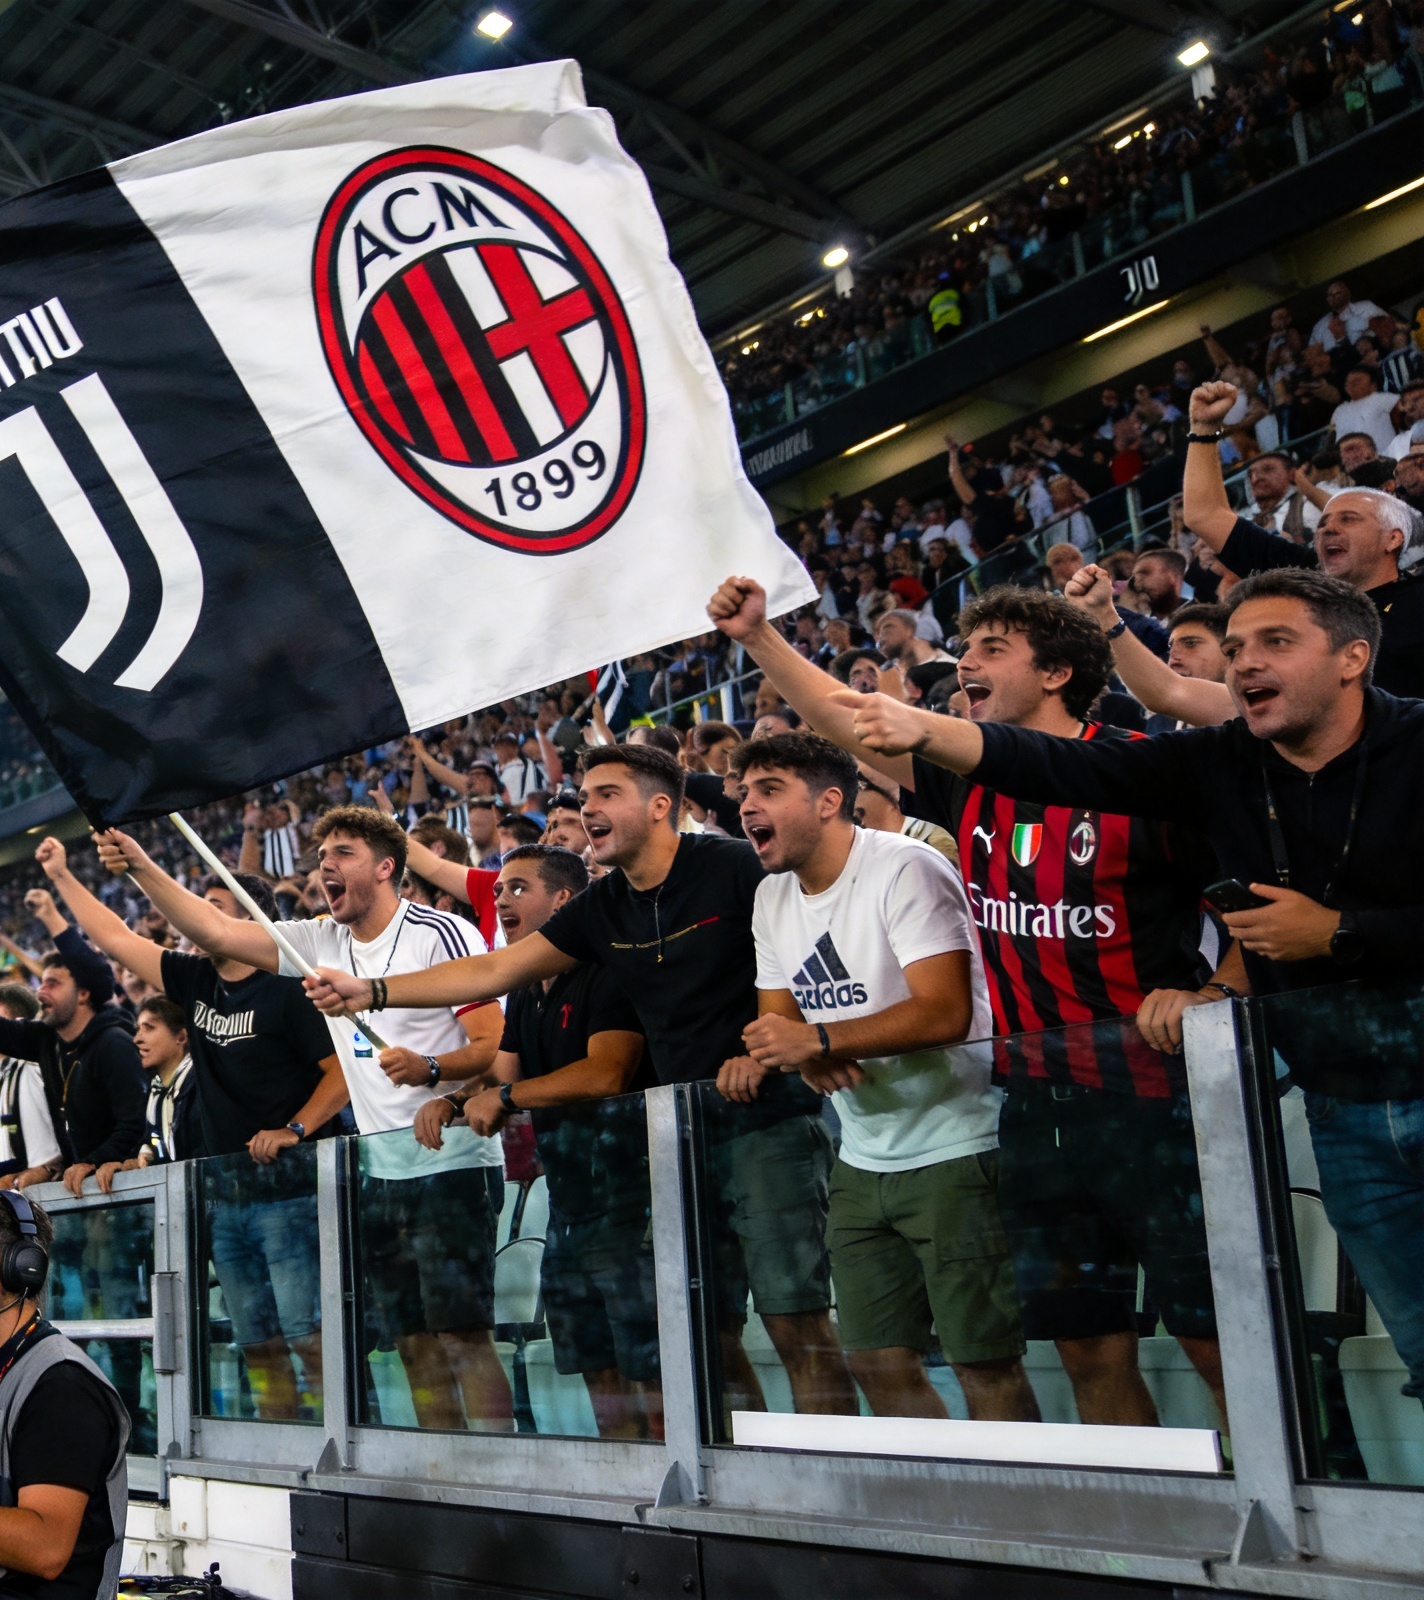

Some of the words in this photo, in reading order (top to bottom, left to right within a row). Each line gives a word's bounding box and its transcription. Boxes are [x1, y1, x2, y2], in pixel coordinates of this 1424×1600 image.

[351, 181, 516, 302] ACM
[483, 439, 606, 517] 1899
[966, 881, 1117, 940] Emirates
